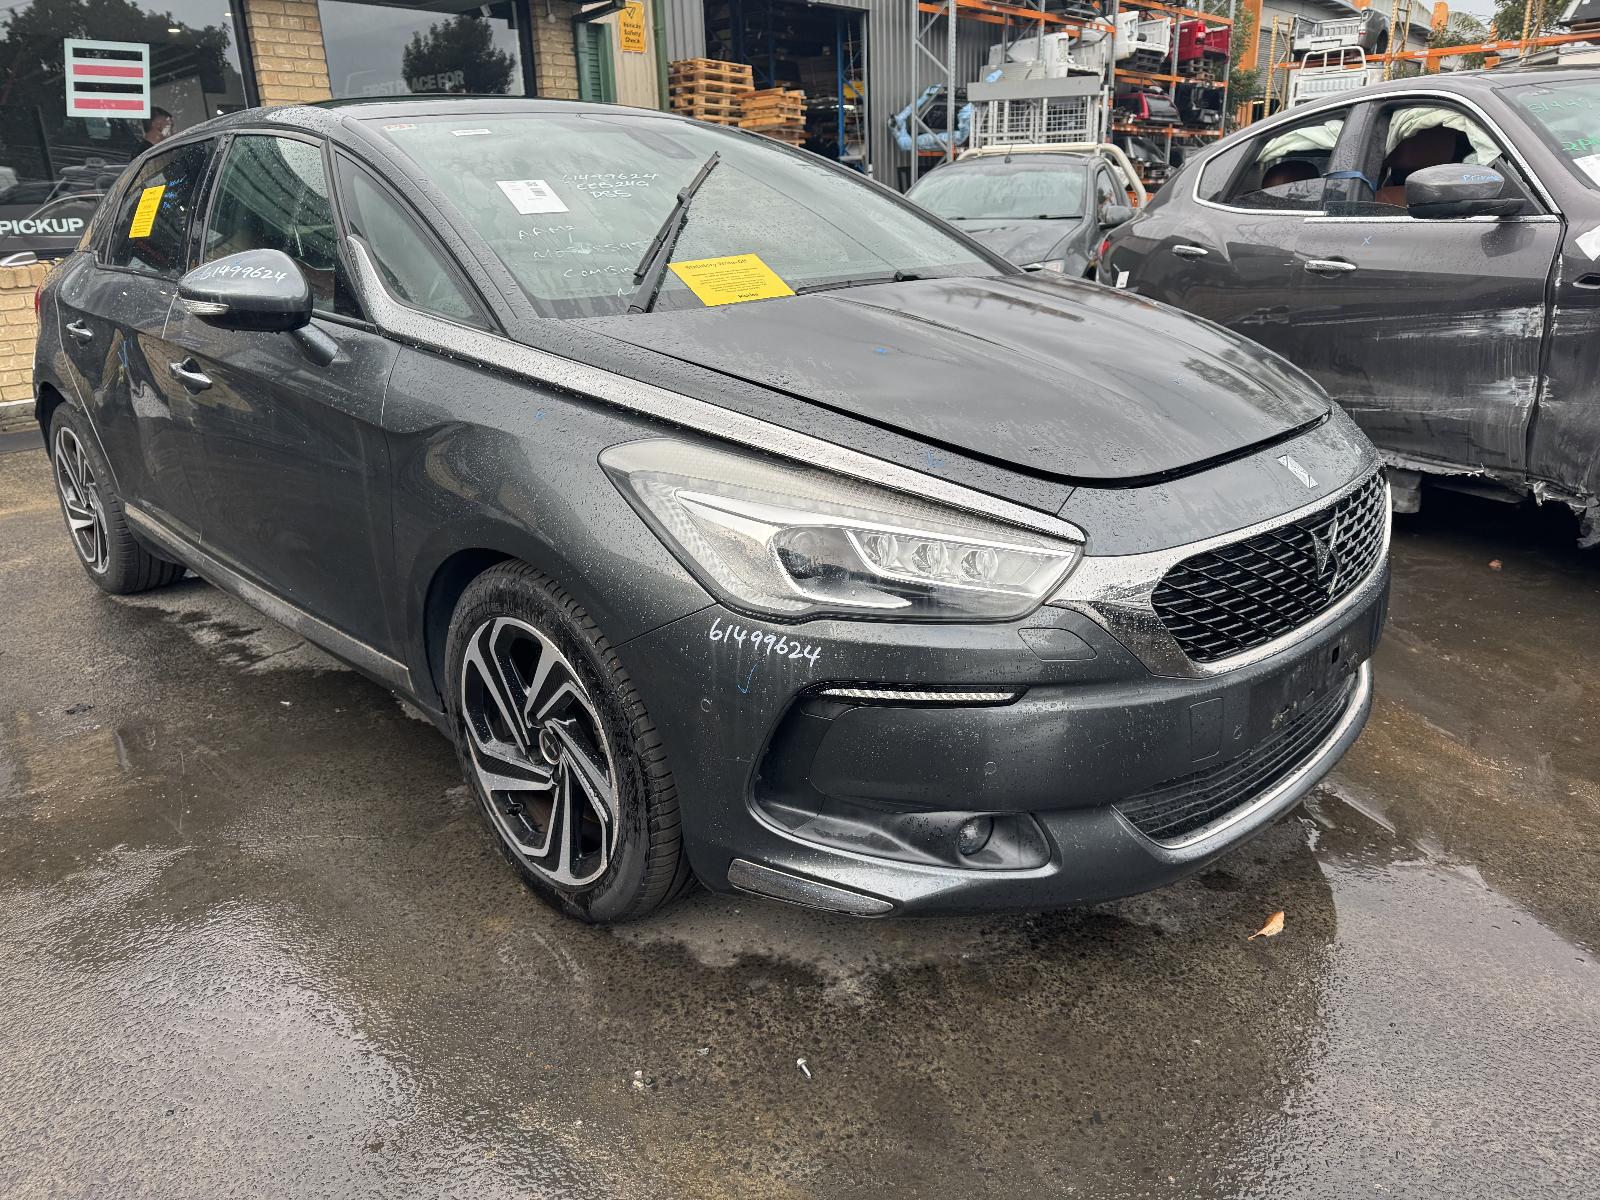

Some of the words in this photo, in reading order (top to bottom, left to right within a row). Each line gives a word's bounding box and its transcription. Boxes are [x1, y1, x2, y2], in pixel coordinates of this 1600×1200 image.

[437, 70, 465, 88] FOR
[0, 217, 84, 235] PICKUP
[199, 264, 287, 284] 61499624
[709, 617, 822, 668] 61499624
